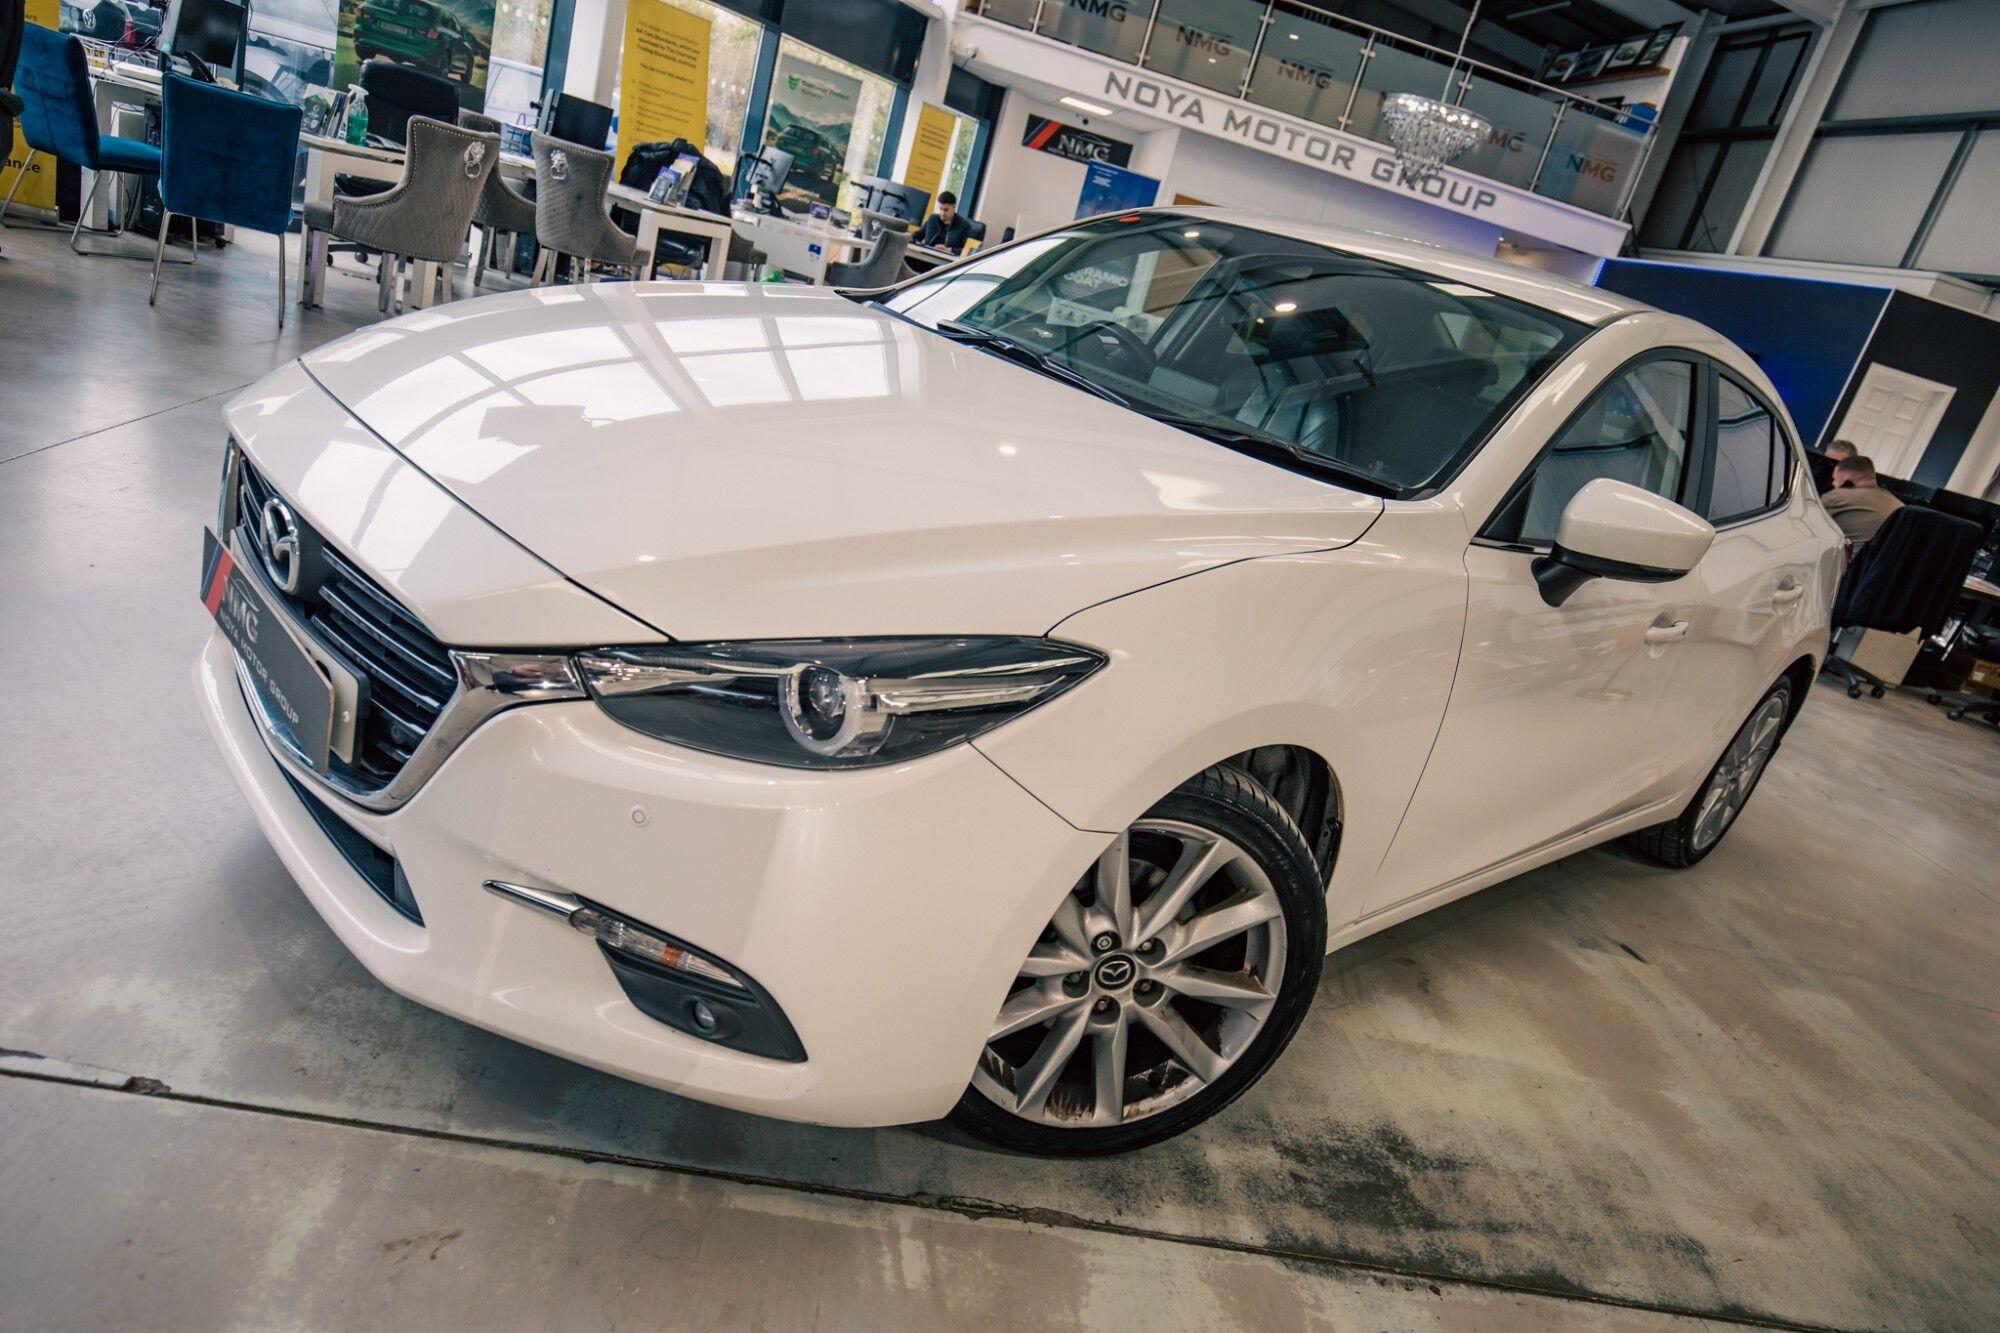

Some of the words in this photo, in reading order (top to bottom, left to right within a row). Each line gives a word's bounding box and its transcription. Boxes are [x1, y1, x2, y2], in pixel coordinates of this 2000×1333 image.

[1070, 0, 1126, 22] NMG
[1176, 25, 1231, 57] NMG
[1278, 58, 1332, 89] NMG
[1105, 71, 1204, 124] NOYA
[1223, 109, 1357, 171] MOTOR
[1058, 134, 1110, 161] NMG
[1487, 128, 1526, 152] MG
[1566, 153, 1616, 182] NMG
[222, 575, 259, 643] NMG
[219, 607, 239, 643] NOYA
[240, 637, 269, 683] MOTOR
[269, 681, 299, 724] GROUP
